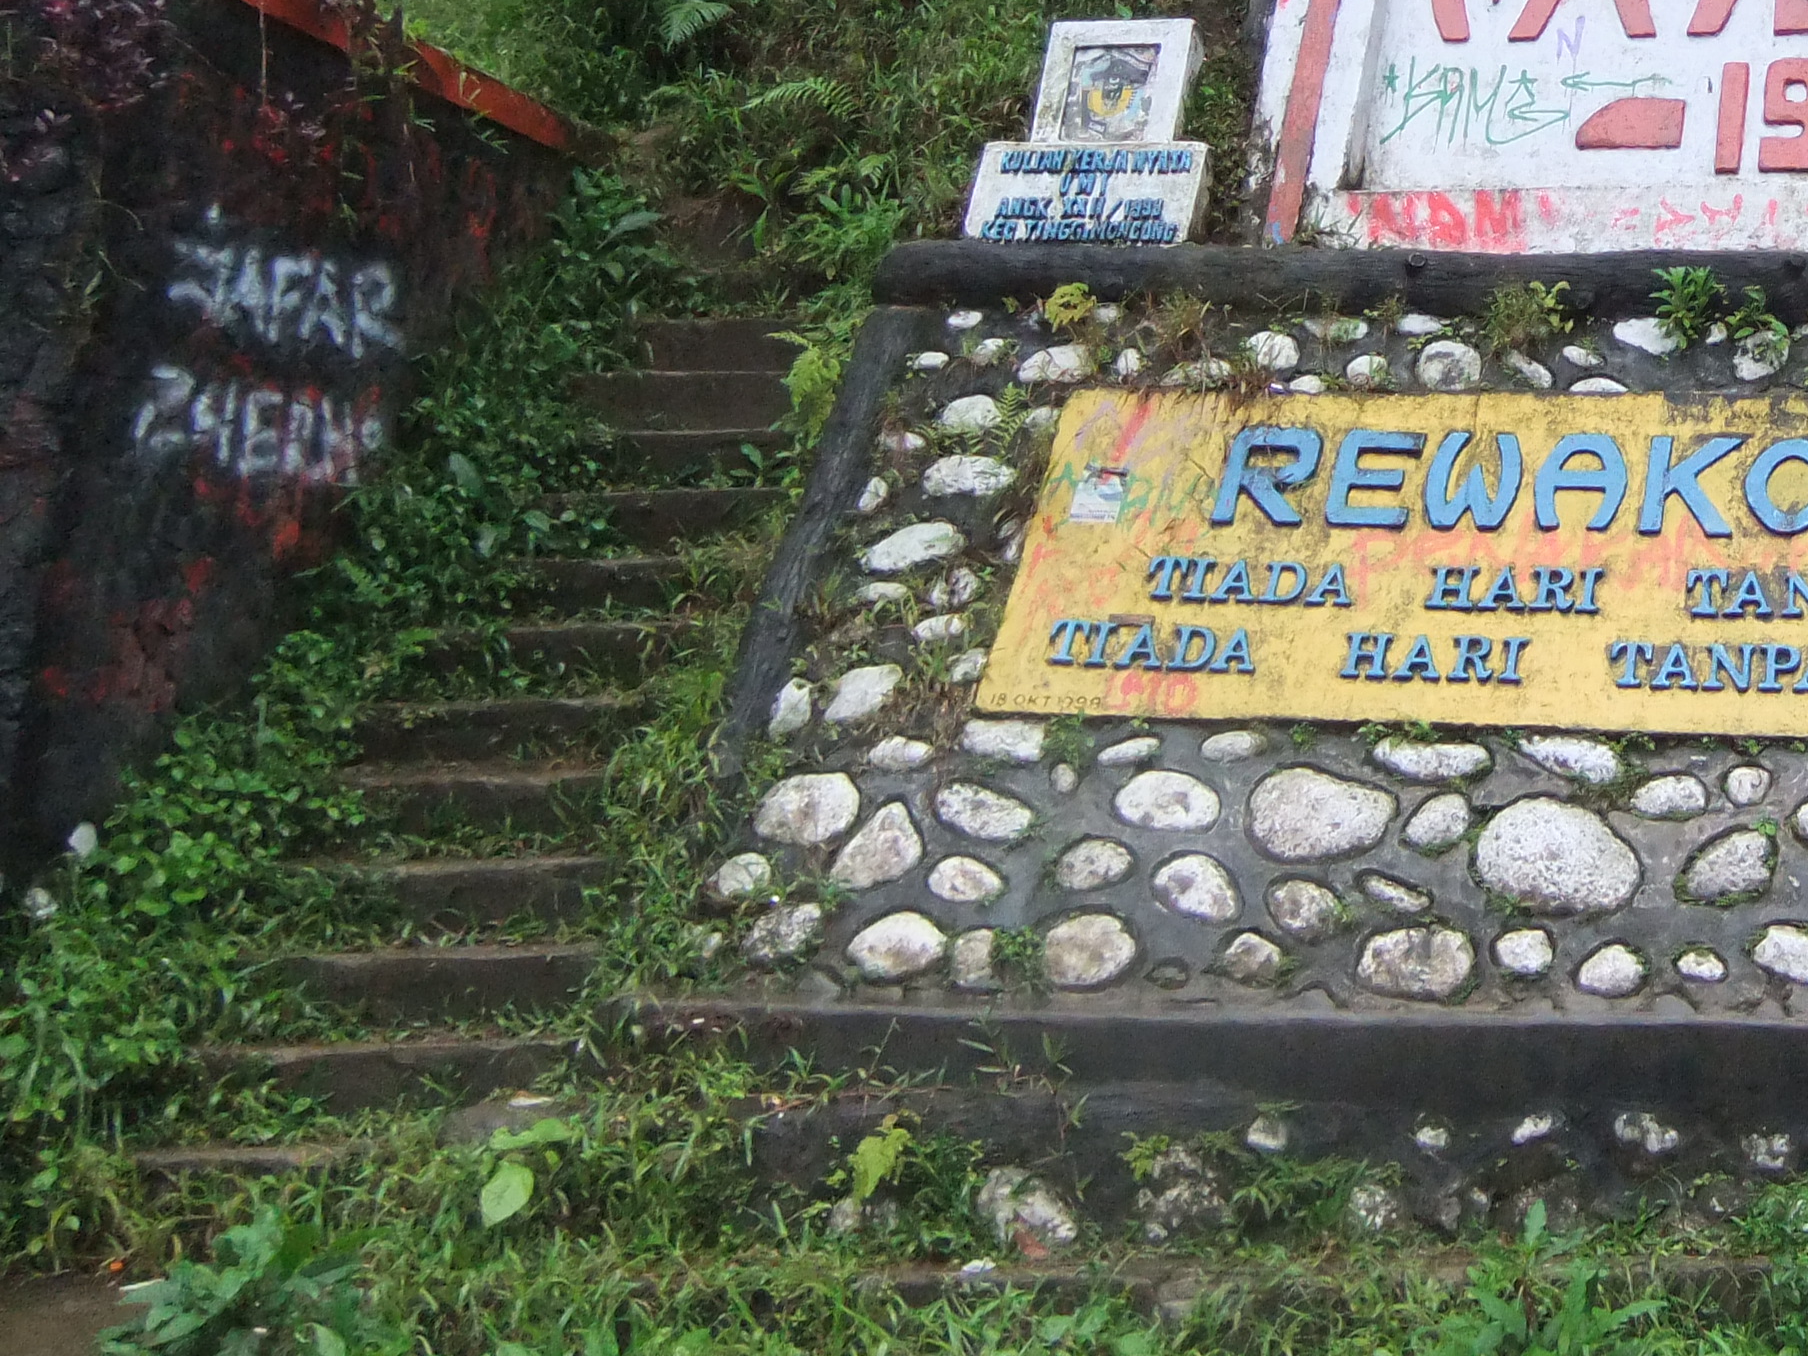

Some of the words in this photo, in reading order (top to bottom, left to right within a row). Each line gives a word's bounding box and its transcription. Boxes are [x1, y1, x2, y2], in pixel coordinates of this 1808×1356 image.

[999, 149, 1065, 174] KULIAH
[1069, 149, 1129, 174] KERJA
[1130, 149, 1194, 174] NYATA
[1148, 554, 1352, 608] TIADA
[1423, 565, 1603, 615] HARI
[1046, 618, 1256, 674] TIADA
[1338, 631, 1532, 685] HARI
